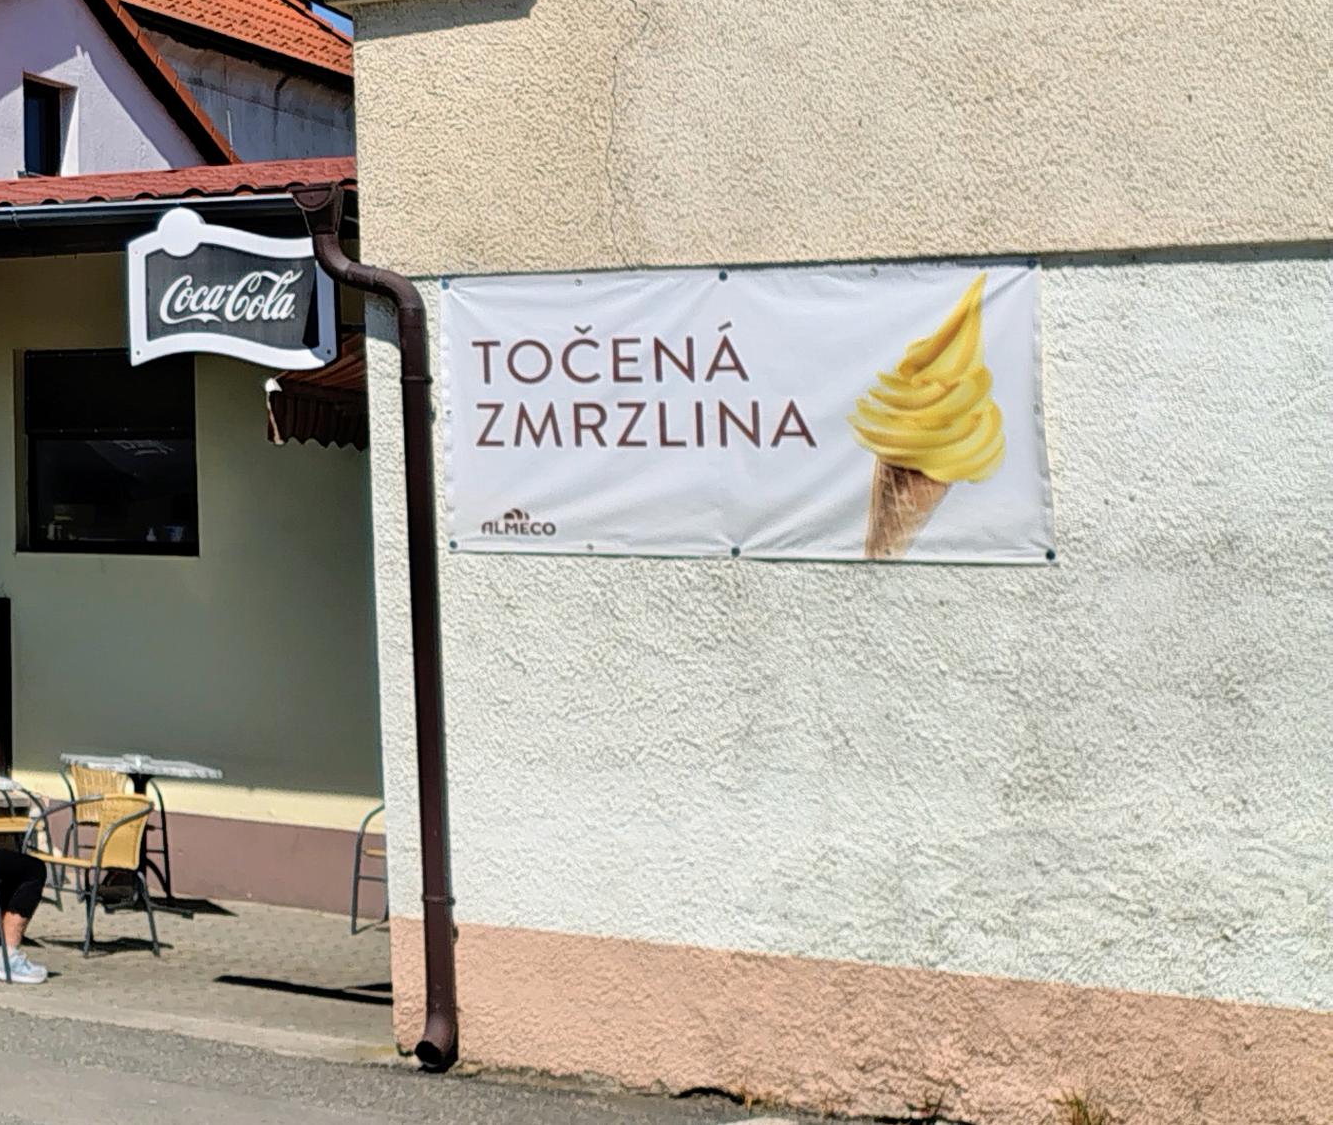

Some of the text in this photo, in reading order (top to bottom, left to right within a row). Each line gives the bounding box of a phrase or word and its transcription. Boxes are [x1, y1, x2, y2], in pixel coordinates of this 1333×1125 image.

[159, 269, 304, 325] Coca-Cola
[472, 321, 749, 386] TOČENÁ
[473, 400, 820, 450] ZMRZLINA
[481, 521, 557, 536] ALMECO
